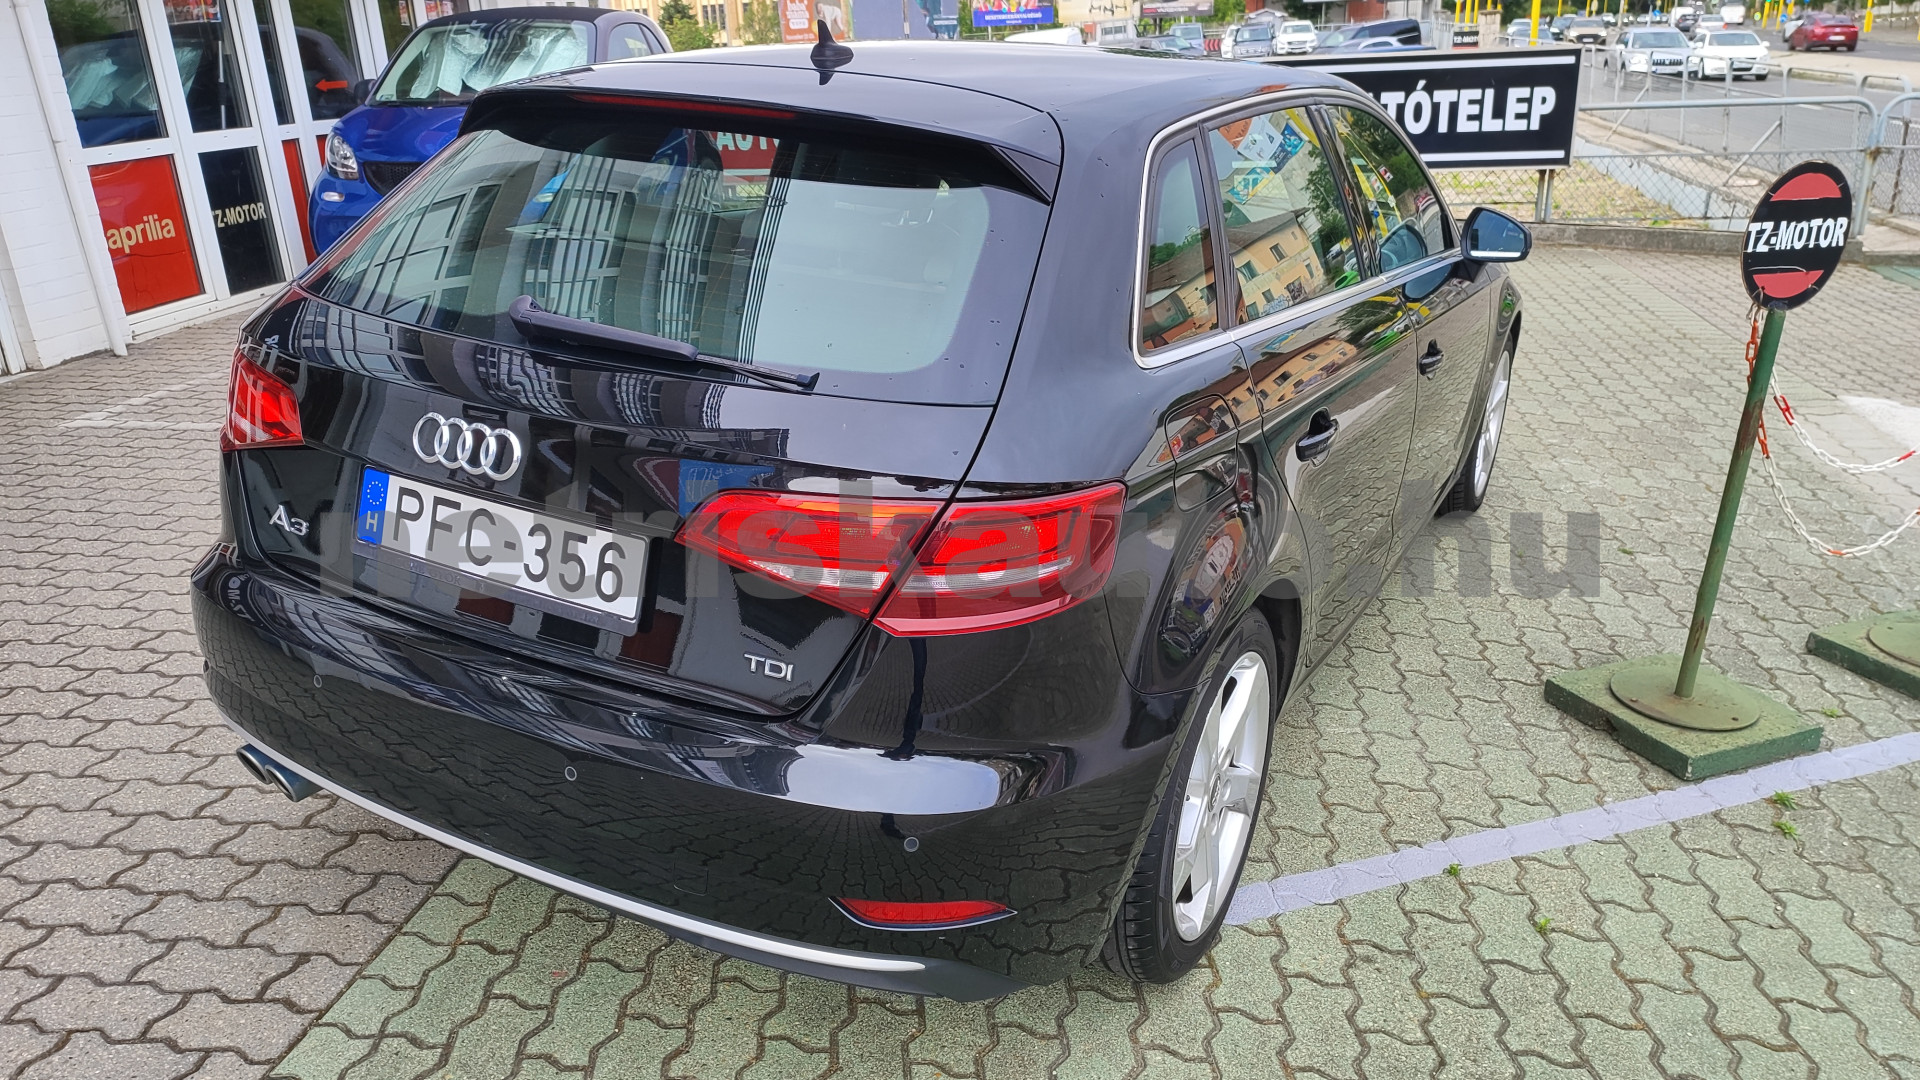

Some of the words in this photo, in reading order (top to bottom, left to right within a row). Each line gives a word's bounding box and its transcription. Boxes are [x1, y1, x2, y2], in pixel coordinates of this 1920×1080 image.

[1370, 80, 1556, 135] TÓTELEP
[212, 202, 266, 228] Z-MOTOR
[106, 214, 176, 253] aprilia
[1747, 217, 1848, 253] TZ-MOTOR
[269, 504, 310, 536] A3
[364, 510, 378, 533] H
[393, 486, 627, 603] PFC-356
[744, 653, 794, 681] TDI
